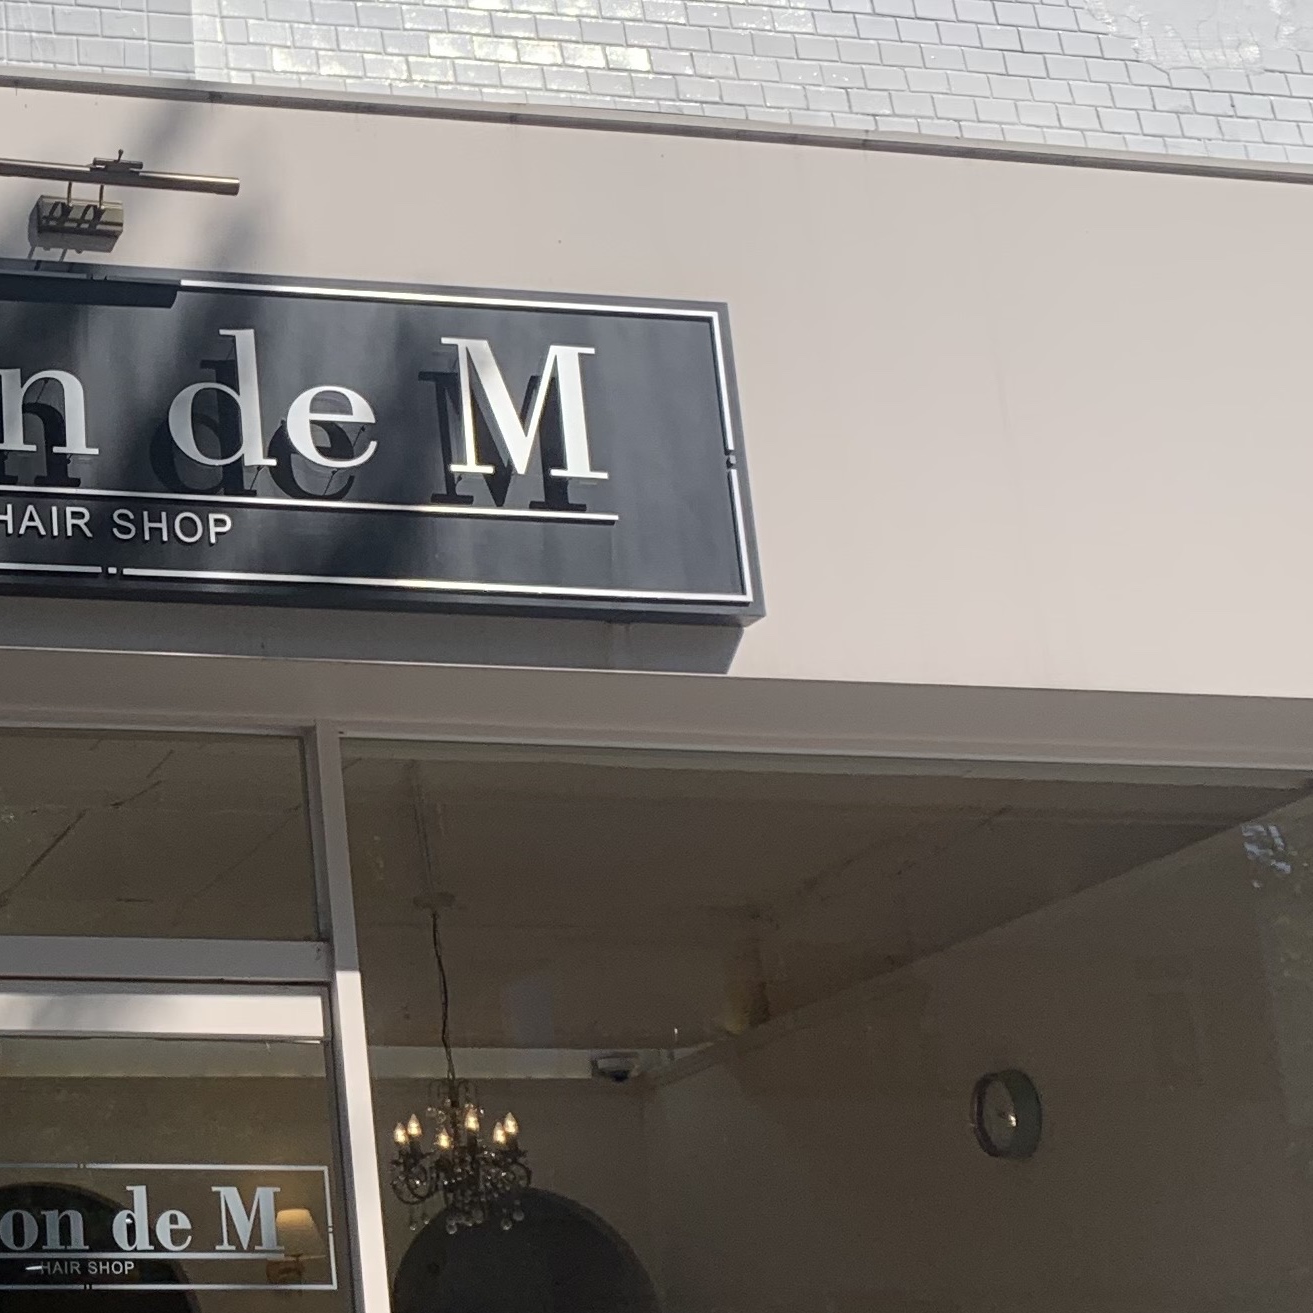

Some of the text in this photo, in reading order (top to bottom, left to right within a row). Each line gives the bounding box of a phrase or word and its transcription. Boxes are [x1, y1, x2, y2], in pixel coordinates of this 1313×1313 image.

[167, 328, 378, 469] de
[440, 336, 610, 480] M
[111, 510, 234, 546] SHOP
[111, 1184, 193, 1252] de
[211, 1185, 285, 1252] M
[40, 1260, 136, 1276] HAIR SHOP
